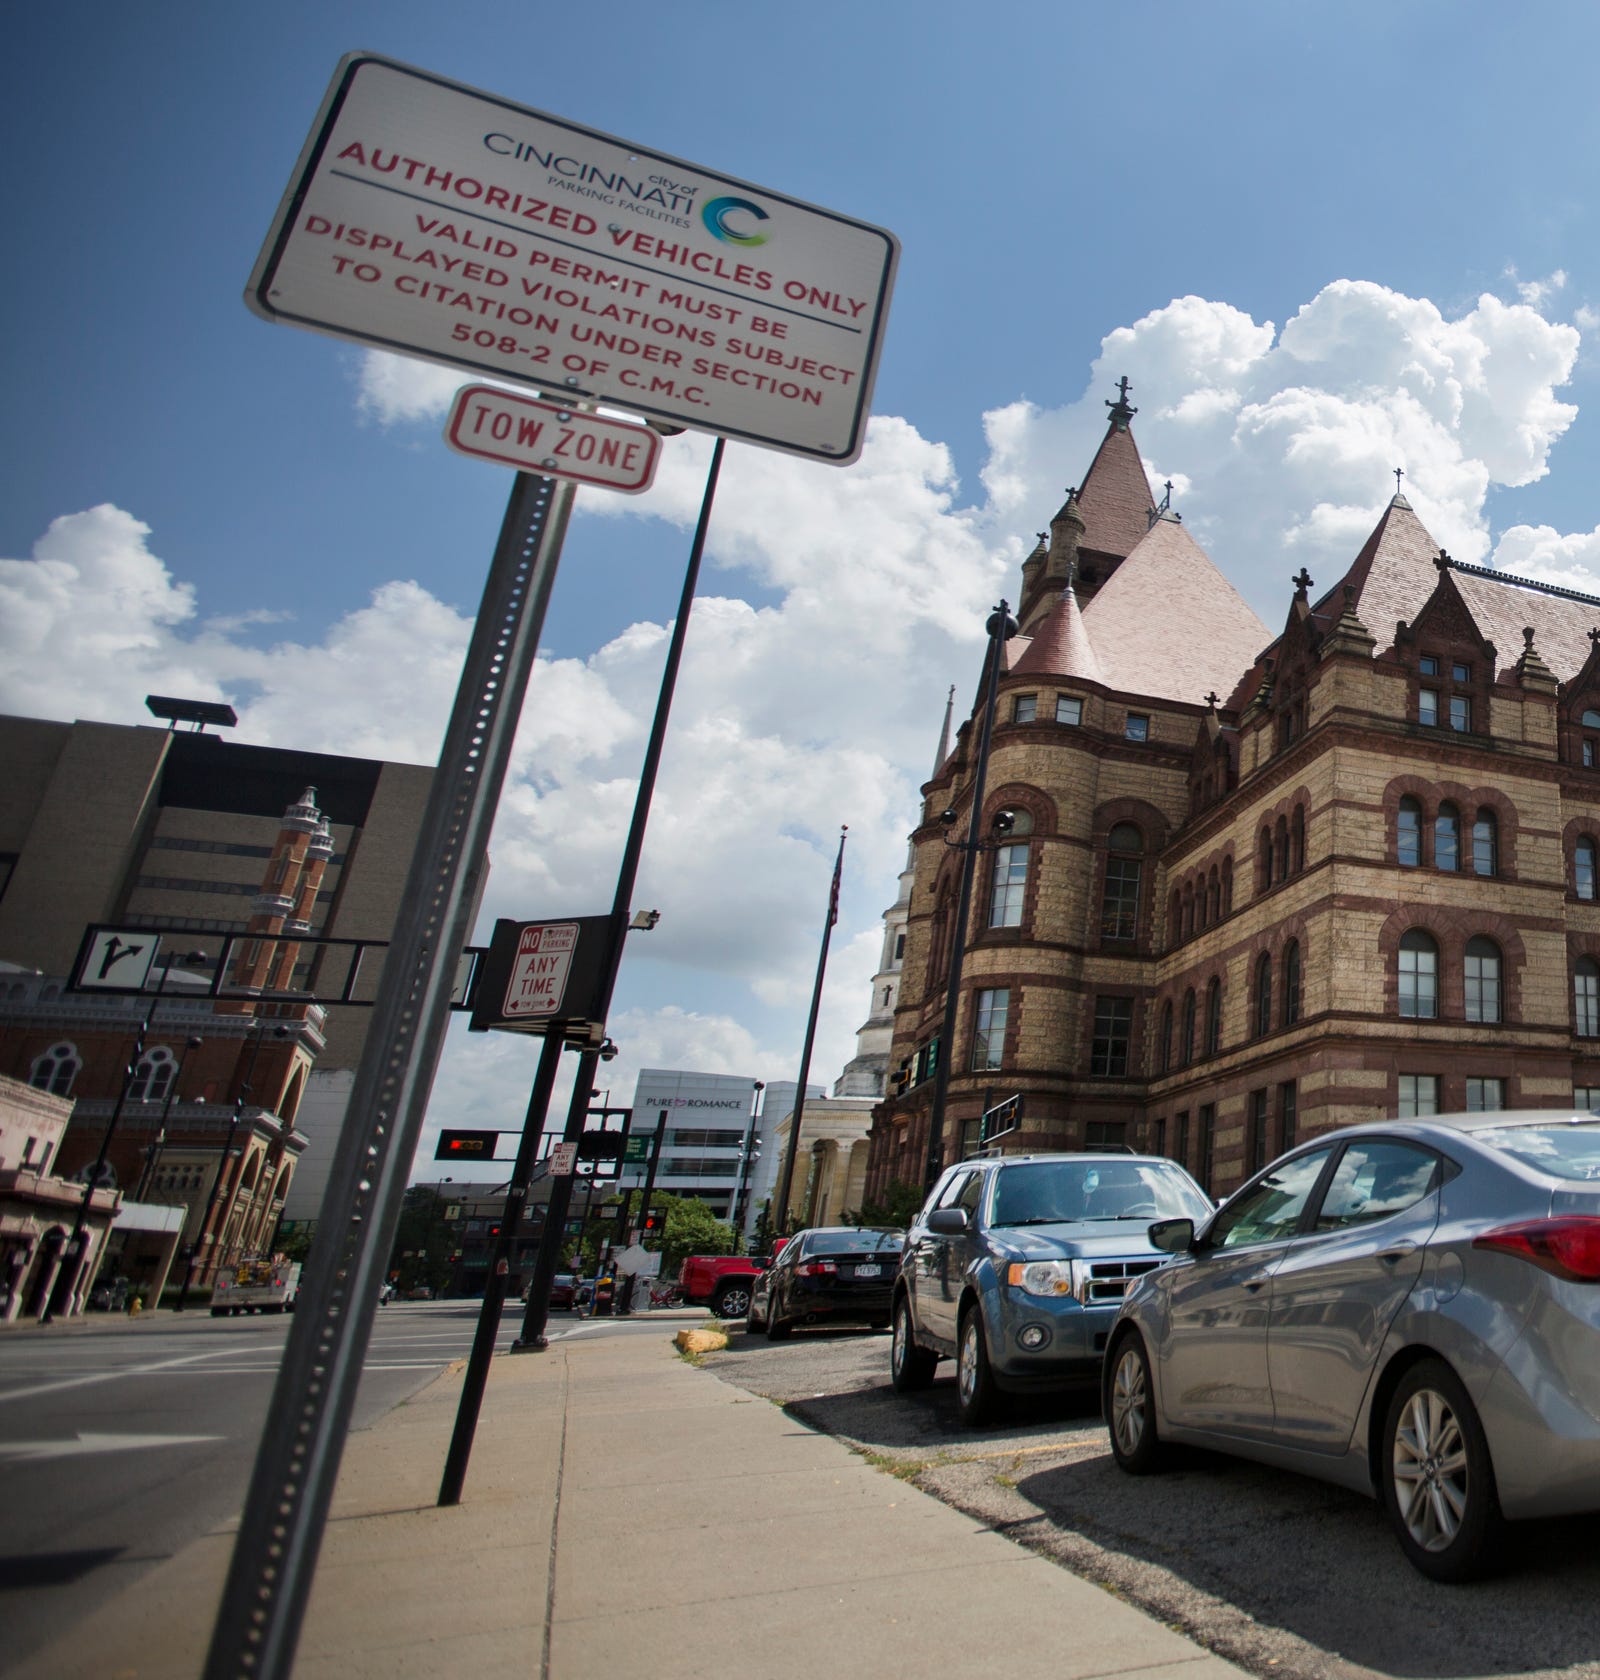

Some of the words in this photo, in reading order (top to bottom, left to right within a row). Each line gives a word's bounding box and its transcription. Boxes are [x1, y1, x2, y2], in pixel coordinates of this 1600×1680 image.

[483, 132, 694, 215] CINCINNATI
[547, 176, 614, 205] PARKING
[618, 199, 691, 229] FACILITIES
[648, 174, 680, 191] city
[680, 186, 700, 195] of
[337, 141, 598, 236] AUTHORIZED
[609, 226, 774, 291] VEHICLES
[783, 280, 868, 319] ONLY
[304, 215, 510, 287] DISPLAYED
[521, 277, 717, 348] VIOLATIONS
[725, 338, 856, 386] SUBJECT
[416, 214, 518, 259] VALID
[528, 250, 650, 298] PERMIT
[658, 289, 742, 325] MUST
[750, 316, 789, 340] BE
[332, 255, 382, 283] TO
[394, 275, 560, 334] CITATION
[570, 324, 684, 368] UNDER
[691, 358, 822, 406] SECTION
[451, 323, 553, 364] 508-2
[562, 354, 610, 377] OF
[618, 369, 711, 407] C.M.C.
[473, 405, 544, 448] TOW
[553, 428, 640, 471] ZONE
[521, 932, 540, 949] NO
[525, 957, 560, 974] ANY
[521, 977, 557, 995] TIME
[646, 1098, 673, 1107] PURE
[687, 1099, 742, 1109] ROMANCE
